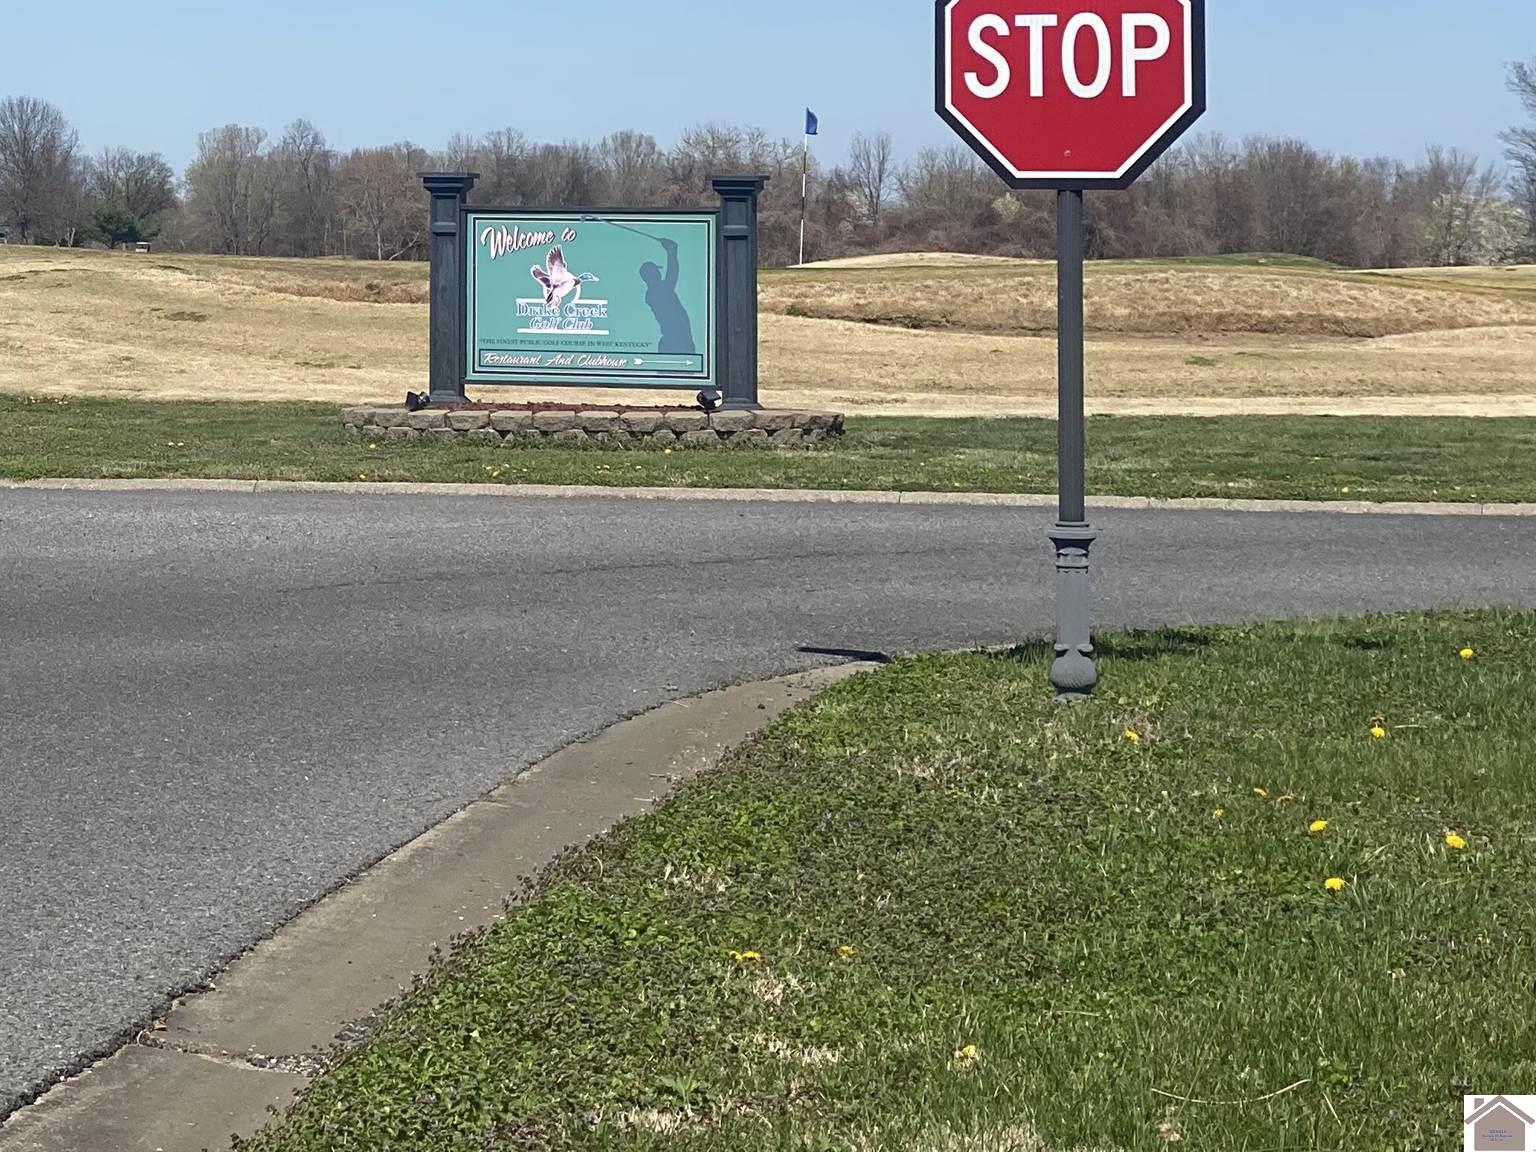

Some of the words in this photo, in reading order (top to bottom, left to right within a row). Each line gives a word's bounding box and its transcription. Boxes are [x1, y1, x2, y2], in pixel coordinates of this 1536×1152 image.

[963, 12, 1170, 99] STOP
[480, 225, 555, 260] Welcome
[561, 227, 577, 241] to
[529, 317, 562, 329] Golf
[562, 317, 594, 330] Club
[483, 352, 542, 365] Restaurant
[545, 353, 574, 367] And
[577, 354, 628, 367] Clubhouse
